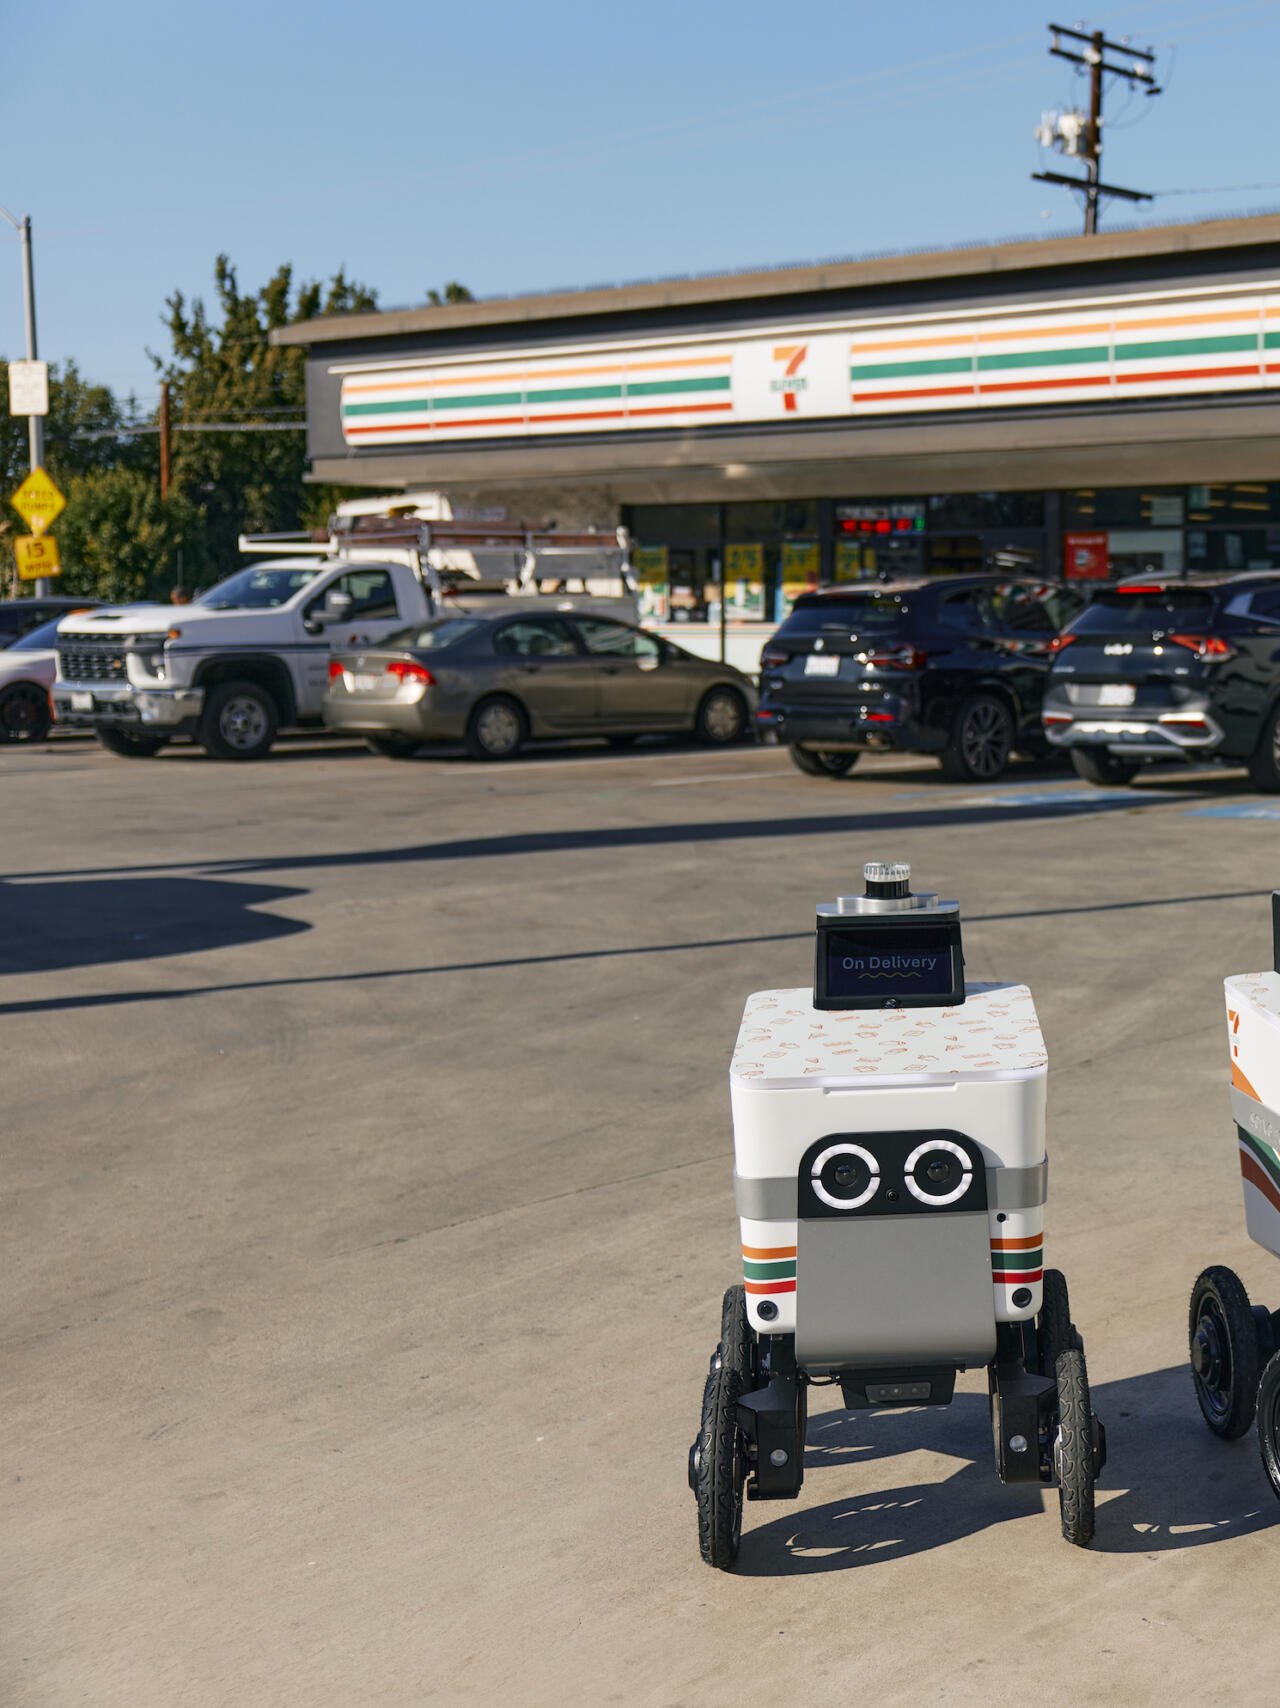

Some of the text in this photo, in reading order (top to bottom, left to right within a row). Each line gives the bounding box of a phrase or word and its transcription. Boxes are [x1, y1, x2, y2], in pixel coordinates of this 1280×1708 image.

[773, 345, 808, 411] 7
[26, 544, 45, 558] 15
[842, 955, 937, 971] On Delivery
